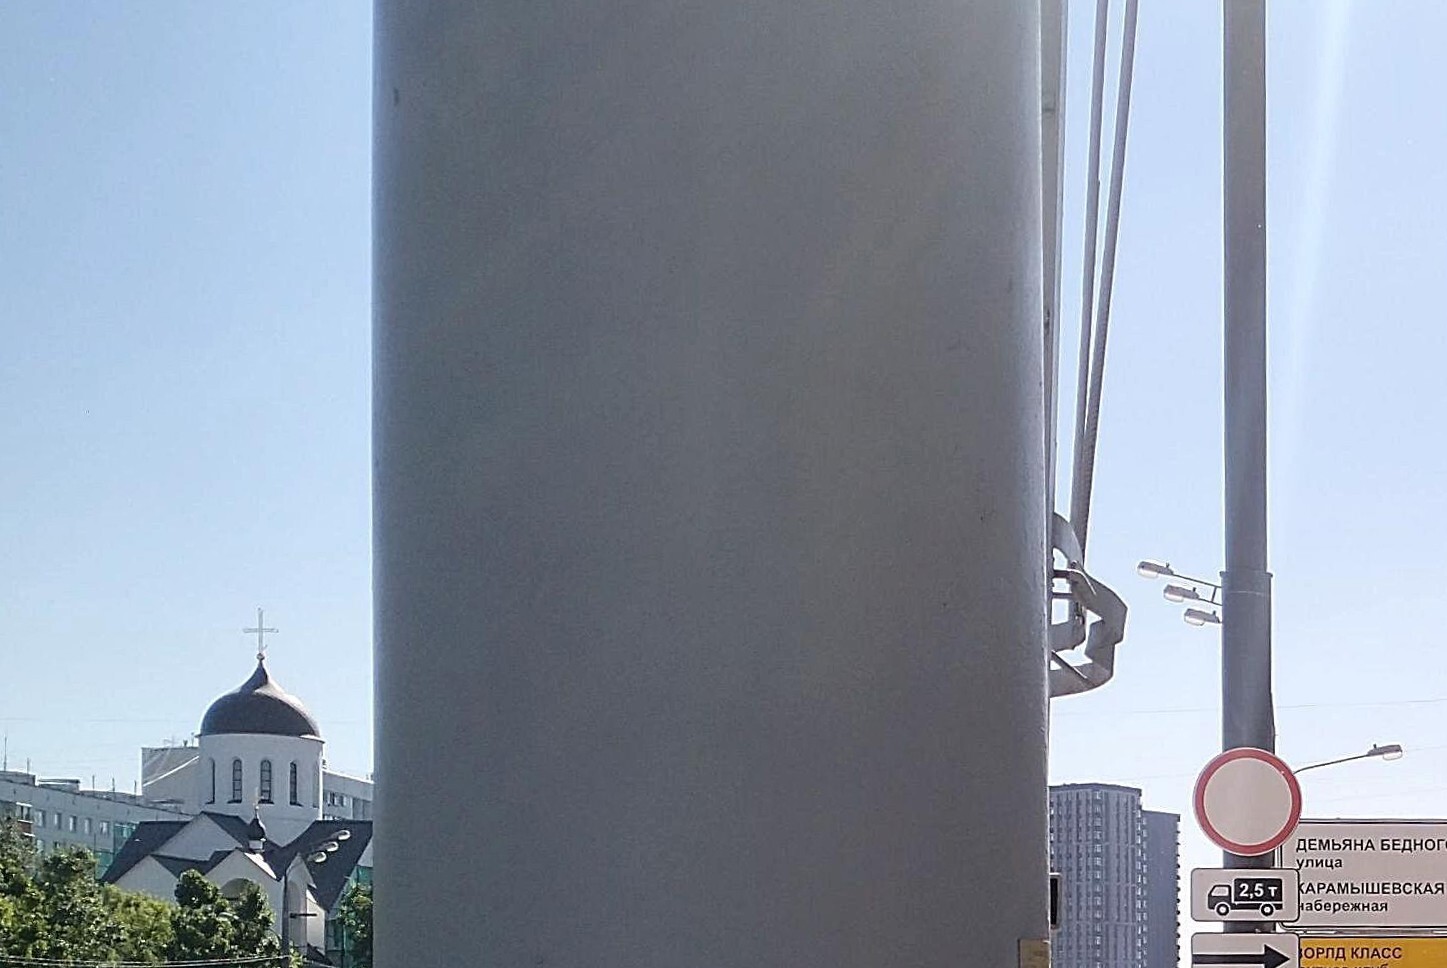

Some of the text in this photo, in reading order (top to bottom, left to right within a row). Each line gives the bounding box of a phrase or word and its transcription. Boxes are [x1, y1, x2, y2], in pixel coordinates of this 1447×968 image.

[1296, 839, 1375, 853] ДЕМЬЯНА
[1296, 858, 1343, 870] улица
[1238, 882, 1264, 898] 2,5
[1351, 947, 1403, 959] КЛАСС
